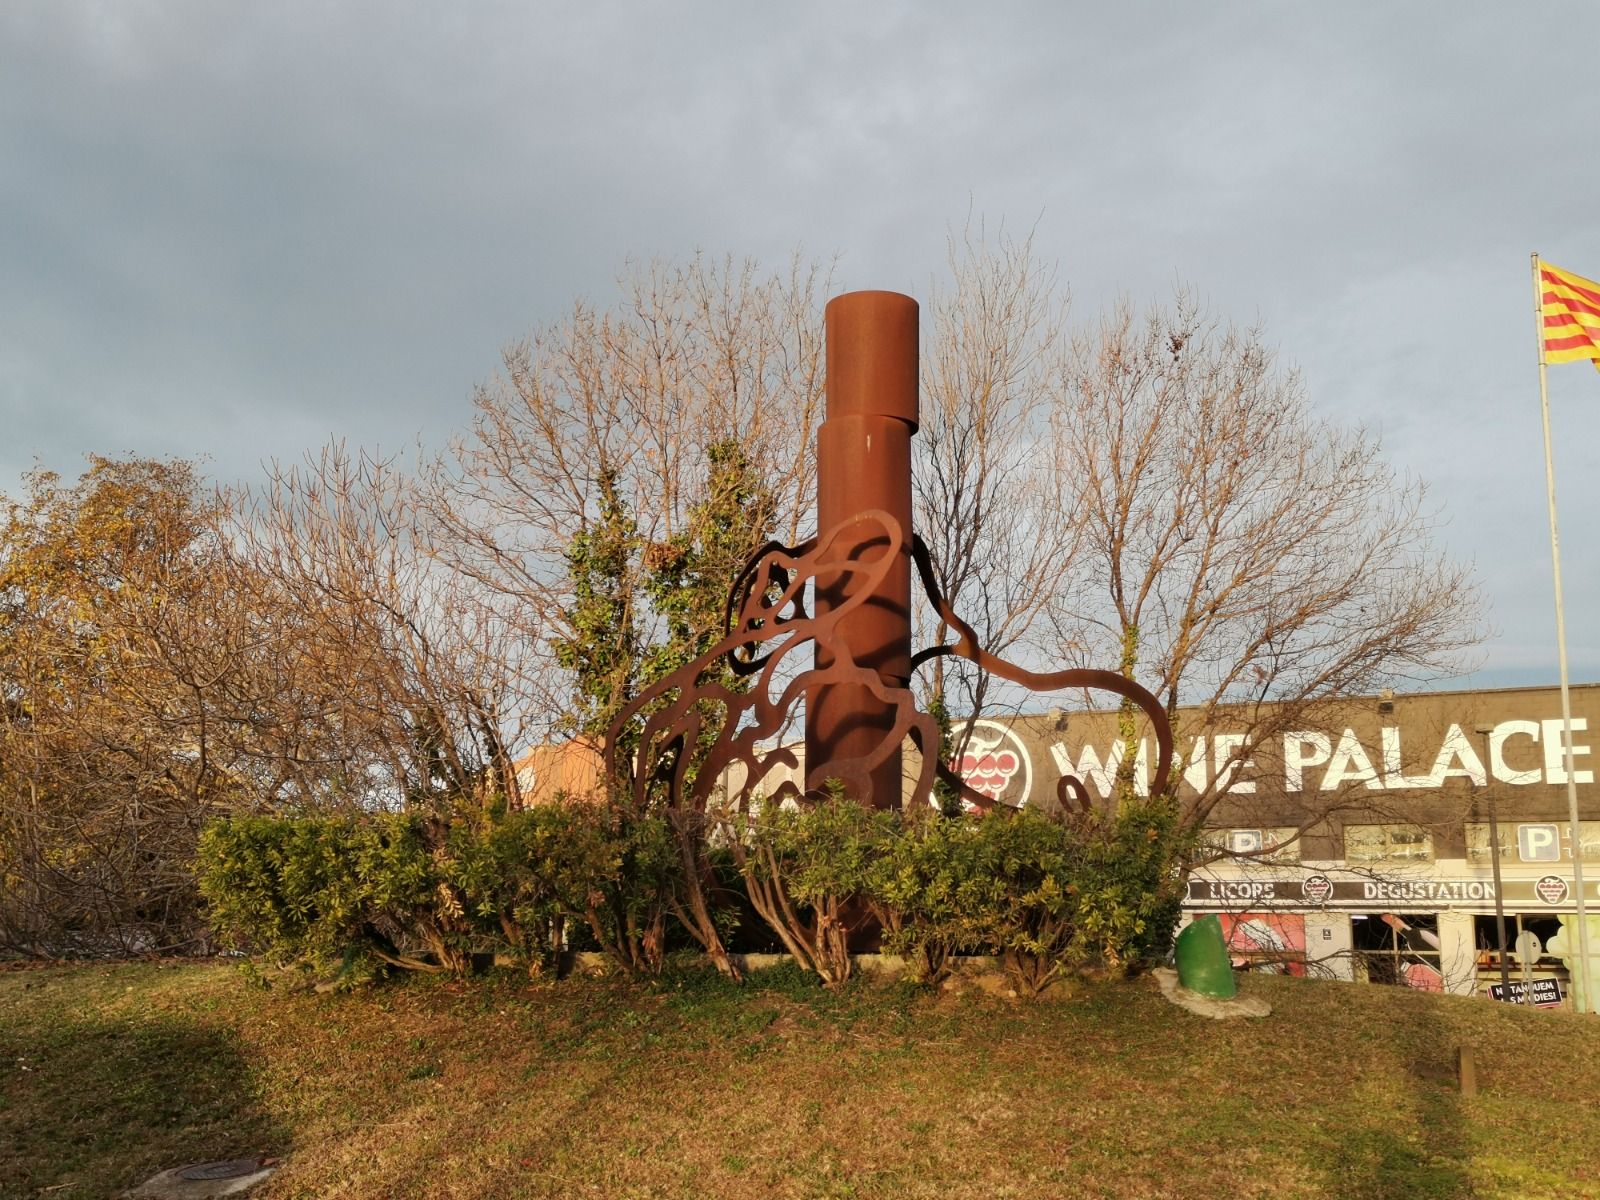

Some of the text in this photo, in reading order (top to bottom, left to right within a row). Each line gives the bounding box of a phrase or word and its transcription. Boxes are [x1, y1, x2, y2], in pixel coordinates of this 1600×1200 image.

[1284, 718, 1594, 792] PALACE
[1527, 828, 1553, 858] P
[1210, 882, 1275, 899] LICORS
[1363, 882, 1497, 899] DEGUSTATION
[1510, 981, 1555, 994] TANUEM
